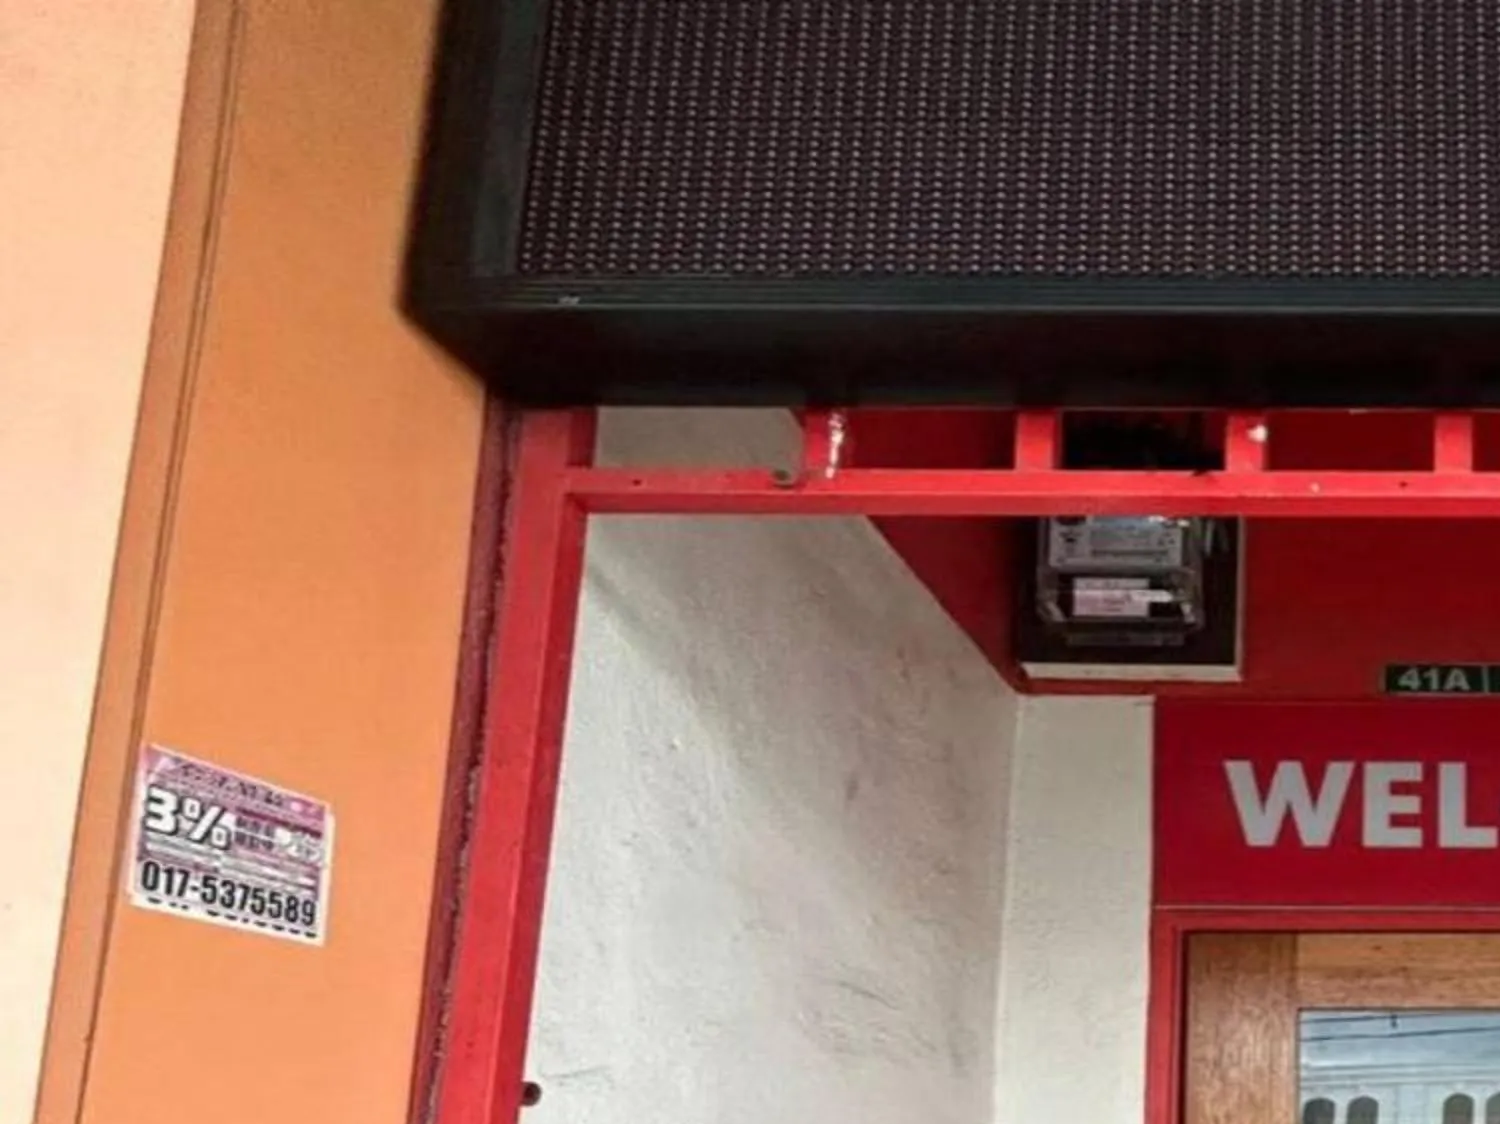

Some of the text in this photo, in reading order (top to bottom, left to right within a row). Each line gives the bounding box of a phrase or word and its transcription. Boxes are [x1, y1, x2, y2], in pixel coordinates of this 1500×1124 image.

[1398, 667, 1470, 691] 41A
[144, 784, 232, 851] 3%
[141, 860, 317, 927] 017-5375589
